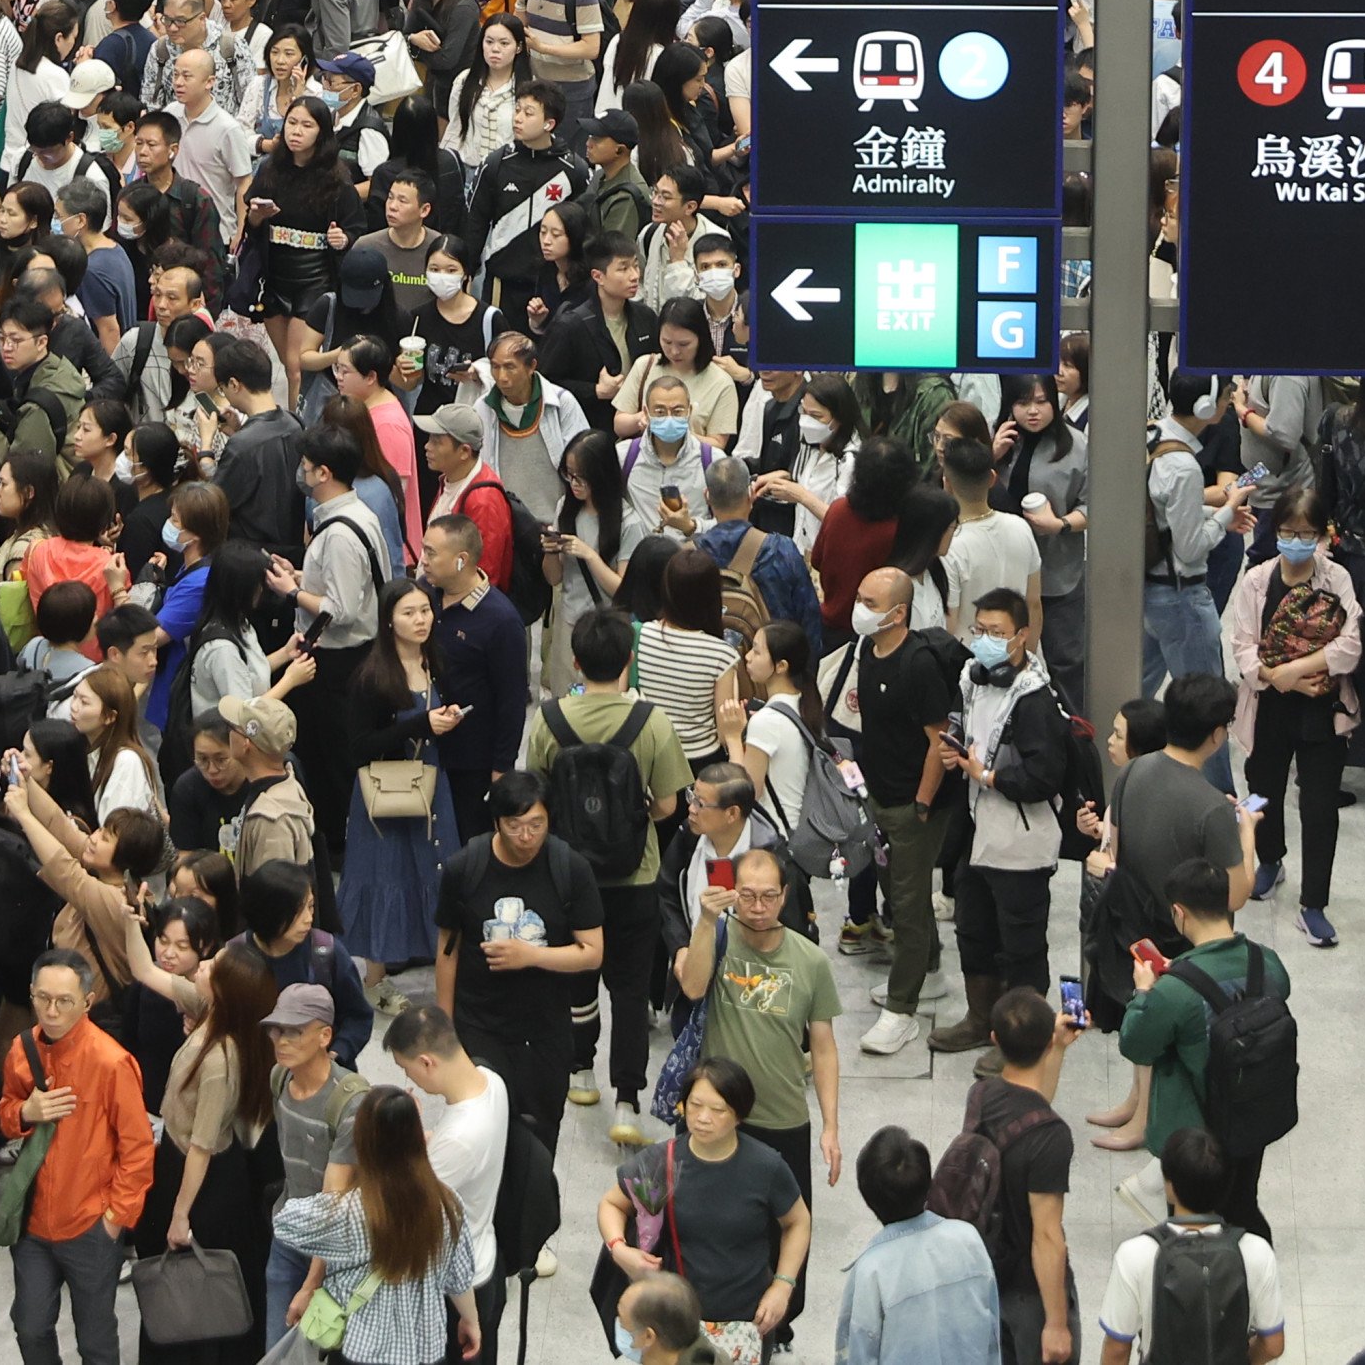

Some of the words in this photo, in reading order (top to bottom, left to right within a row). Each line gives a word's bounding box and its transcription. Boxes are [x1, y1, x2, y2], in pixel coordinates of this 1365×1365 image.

[961, 44, 988, 87] 2
[1254, 53, 1287, 94] 4
[853, 125, 946, 170] 金鐘
[852, 173, 955, 199] Admiralty
[1275, 182, 1310, 203] Wu
[1315, 182, 1349, 203] Kai
[388, 270, 428, 286] Columb
[998, 247, 1021, 285] F
[876, 312, 935, 331] EXIT
[991, 310, 1024, 350] G
